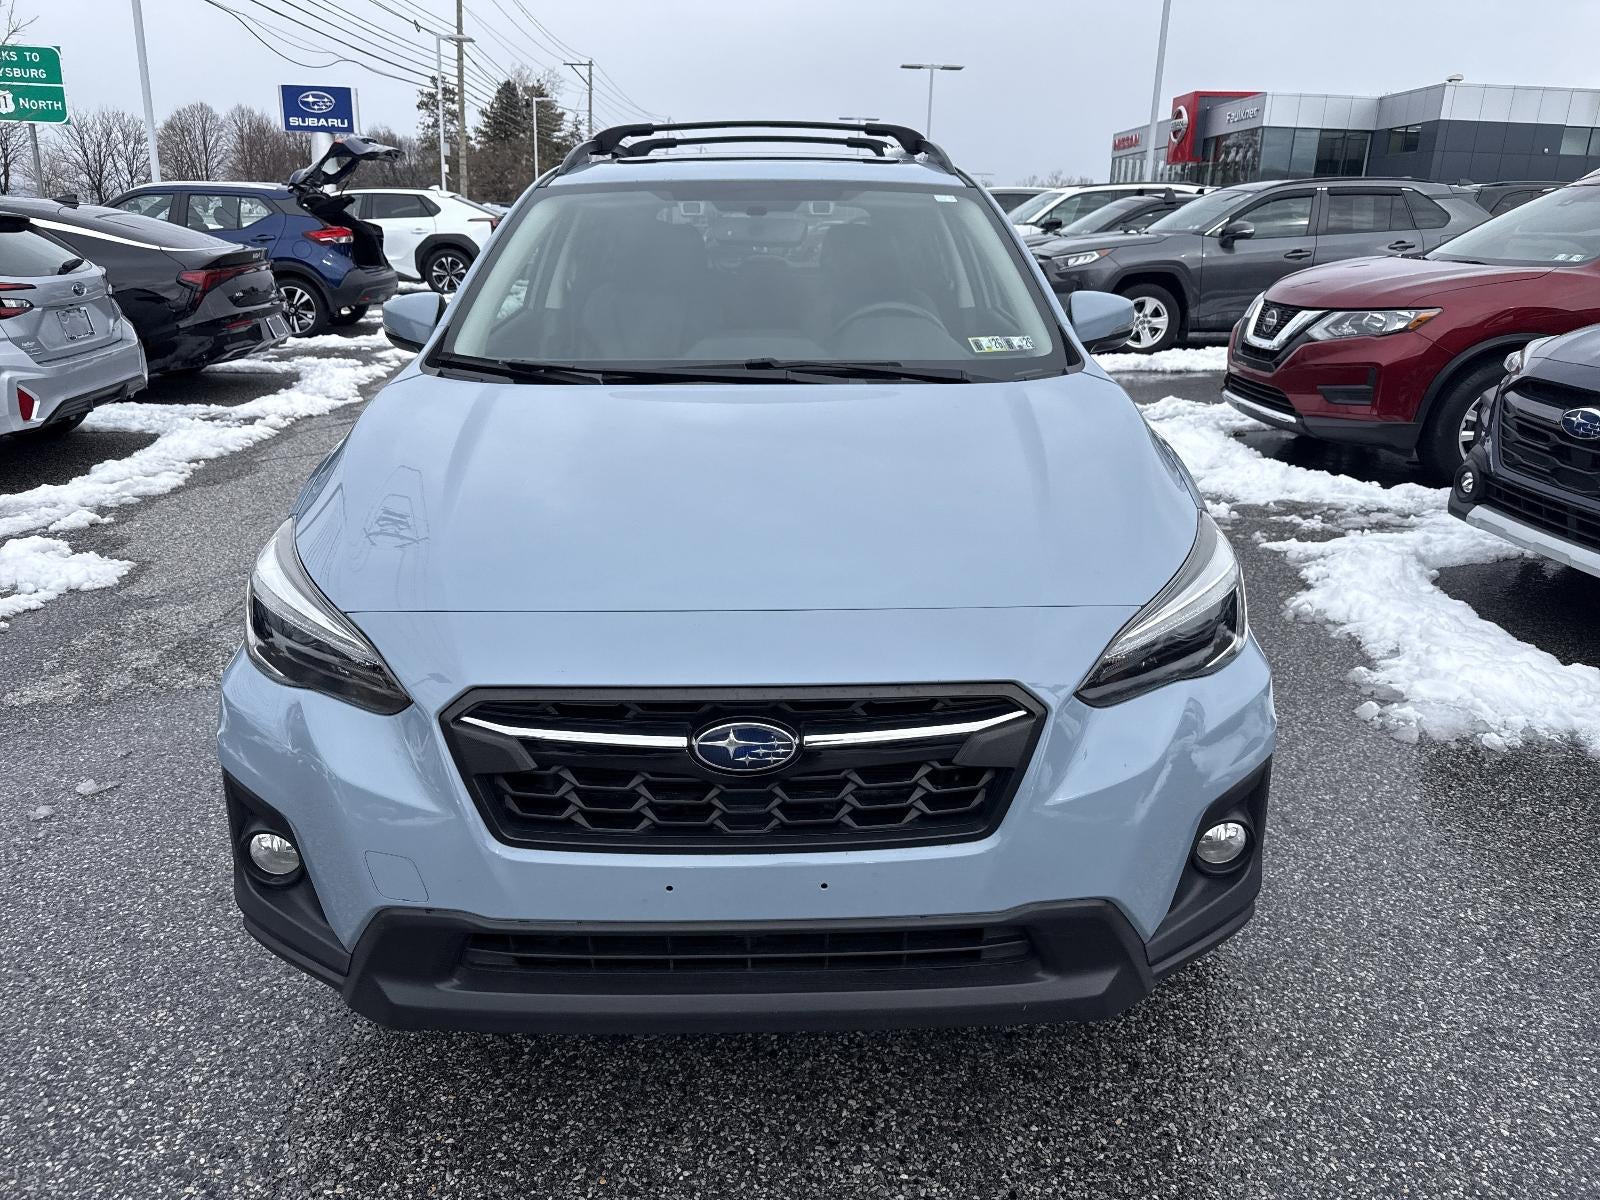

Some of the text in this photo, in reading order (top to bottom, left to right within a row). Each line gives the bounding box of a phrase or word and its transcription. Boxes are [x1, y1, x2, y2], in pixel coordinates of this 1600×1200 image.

[0, 50, 40, 63] KS TO
[18, 97, 62, 111] NORTH
[1226, 106, 1258, 123] Faulkner
[289, 116, 349, 128] SUBARU
